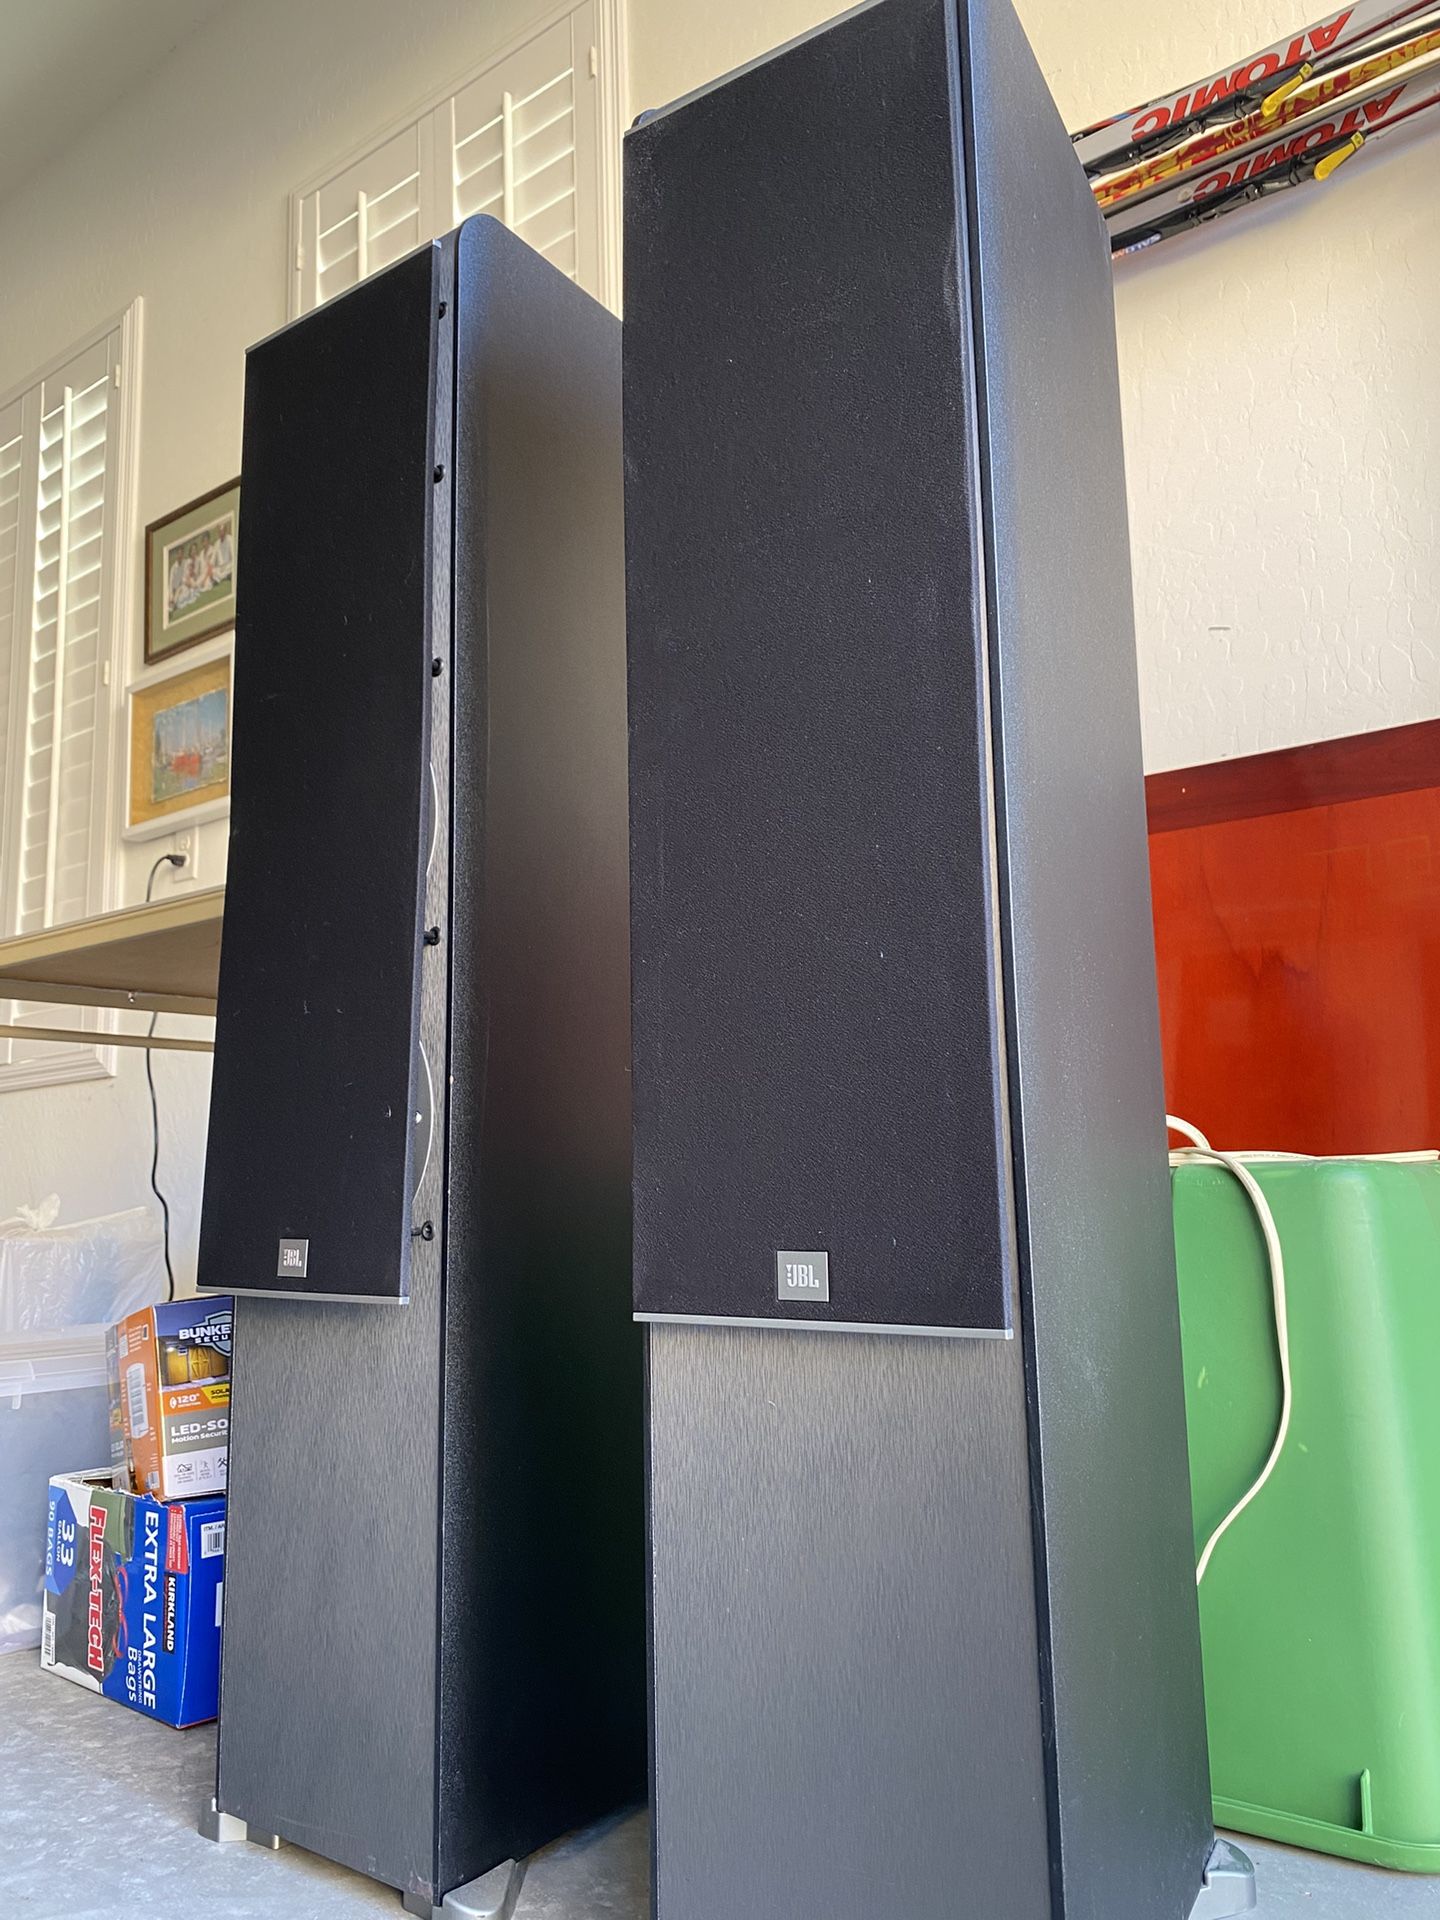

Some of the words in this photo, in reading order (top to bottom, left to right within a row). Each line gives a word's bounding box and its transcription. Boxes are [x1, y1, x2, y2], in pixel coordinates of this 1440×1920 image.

[1132, 9, 1353, 141] ATOMIC
[1193, 84, 1407, 201] ATOMIC
[283, 1248, 302, 1267] JBL
[785, 1264, 819, 1288] JBL
[172, 1434, 199, 1444] Motion
[48, 1501, 55, 1522] 90
[45, 1527, 54, 1576] BAGS
[60, 1519, 75, 1567] 33
[143, 1511, 159, 1604] EXTRA
[88, 1505, 107, 1672] FLEX-TECH
[167, 1576, 176, 1651] KIRKLAND
[125, 1646, 138, 1702] Bags
[142, 1612, 157, 1710] LARGE
